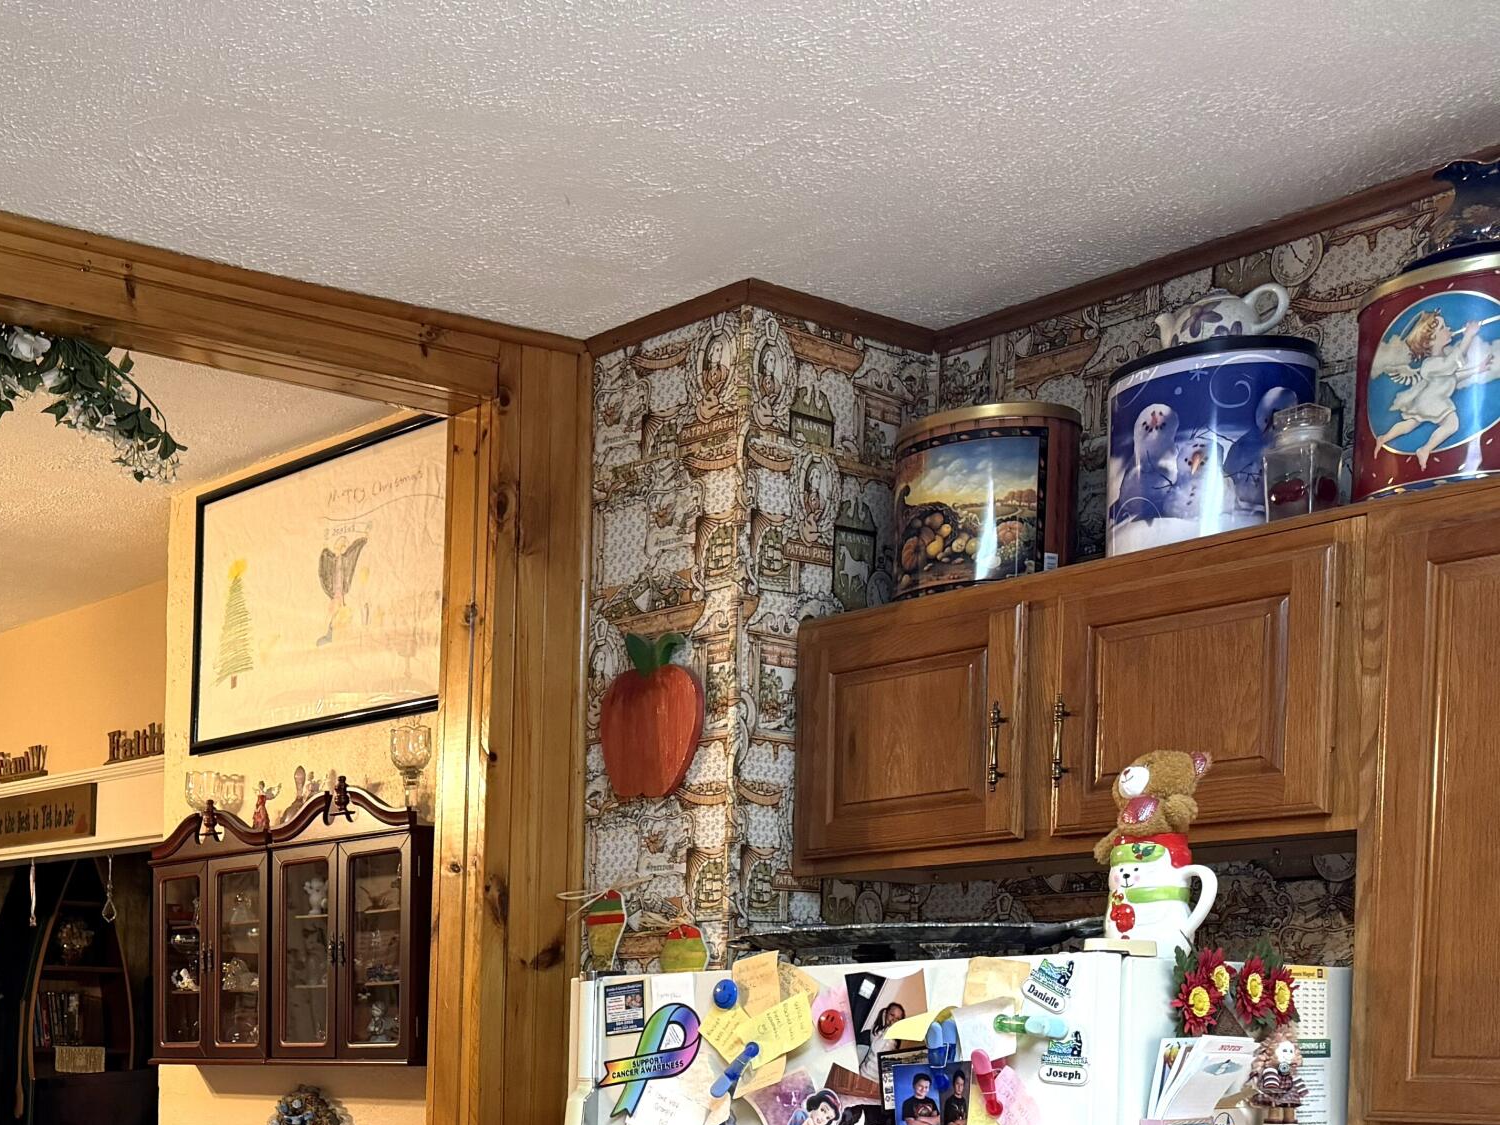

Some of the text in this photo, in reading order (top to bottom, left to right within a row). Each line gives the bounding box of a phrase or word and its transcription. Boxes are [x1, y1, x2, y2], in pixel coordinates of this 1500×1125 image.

[1027, 984, 1060, 1009] Danielle
[1219, 1044, 1243, 1052] NOTES
[632, 1056, 663, 1068] SUPPORT
[612, 1060, 684, 1079] CANCER AWARENESS
[1046, 1067, 1082, 1081] Joseph
